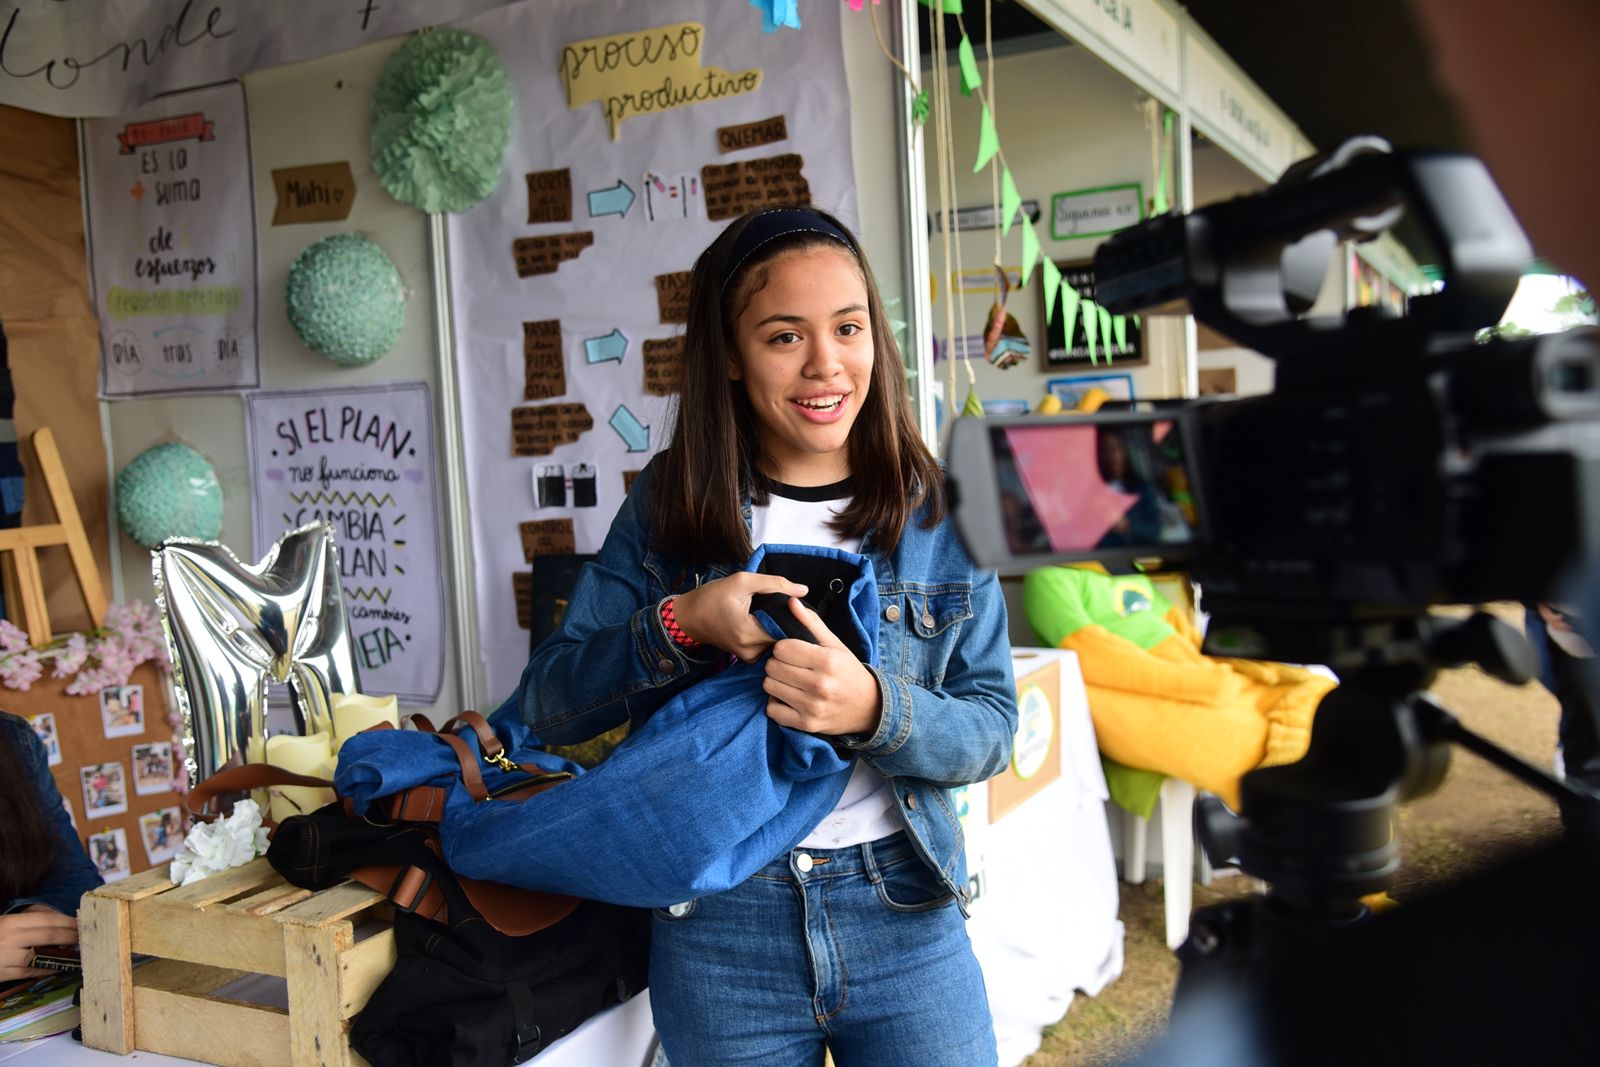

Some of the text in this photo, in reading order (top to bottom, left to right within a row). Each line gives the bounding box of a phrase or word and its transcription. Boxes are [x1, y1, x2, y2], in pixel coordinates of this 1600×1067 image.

[558, 26, 701, 105] proceso
[606, 71, 758, 141] productivo
[720, 120, 785, 148] QUEMAR
[150, 226, 173, 254] de
[277, 405, 412, 460] SI EL PLAN
[288, 455, 400, 490] no funciona
[341, 546, 387, 577] LAN
[353, 626, 406, 670] ETA
